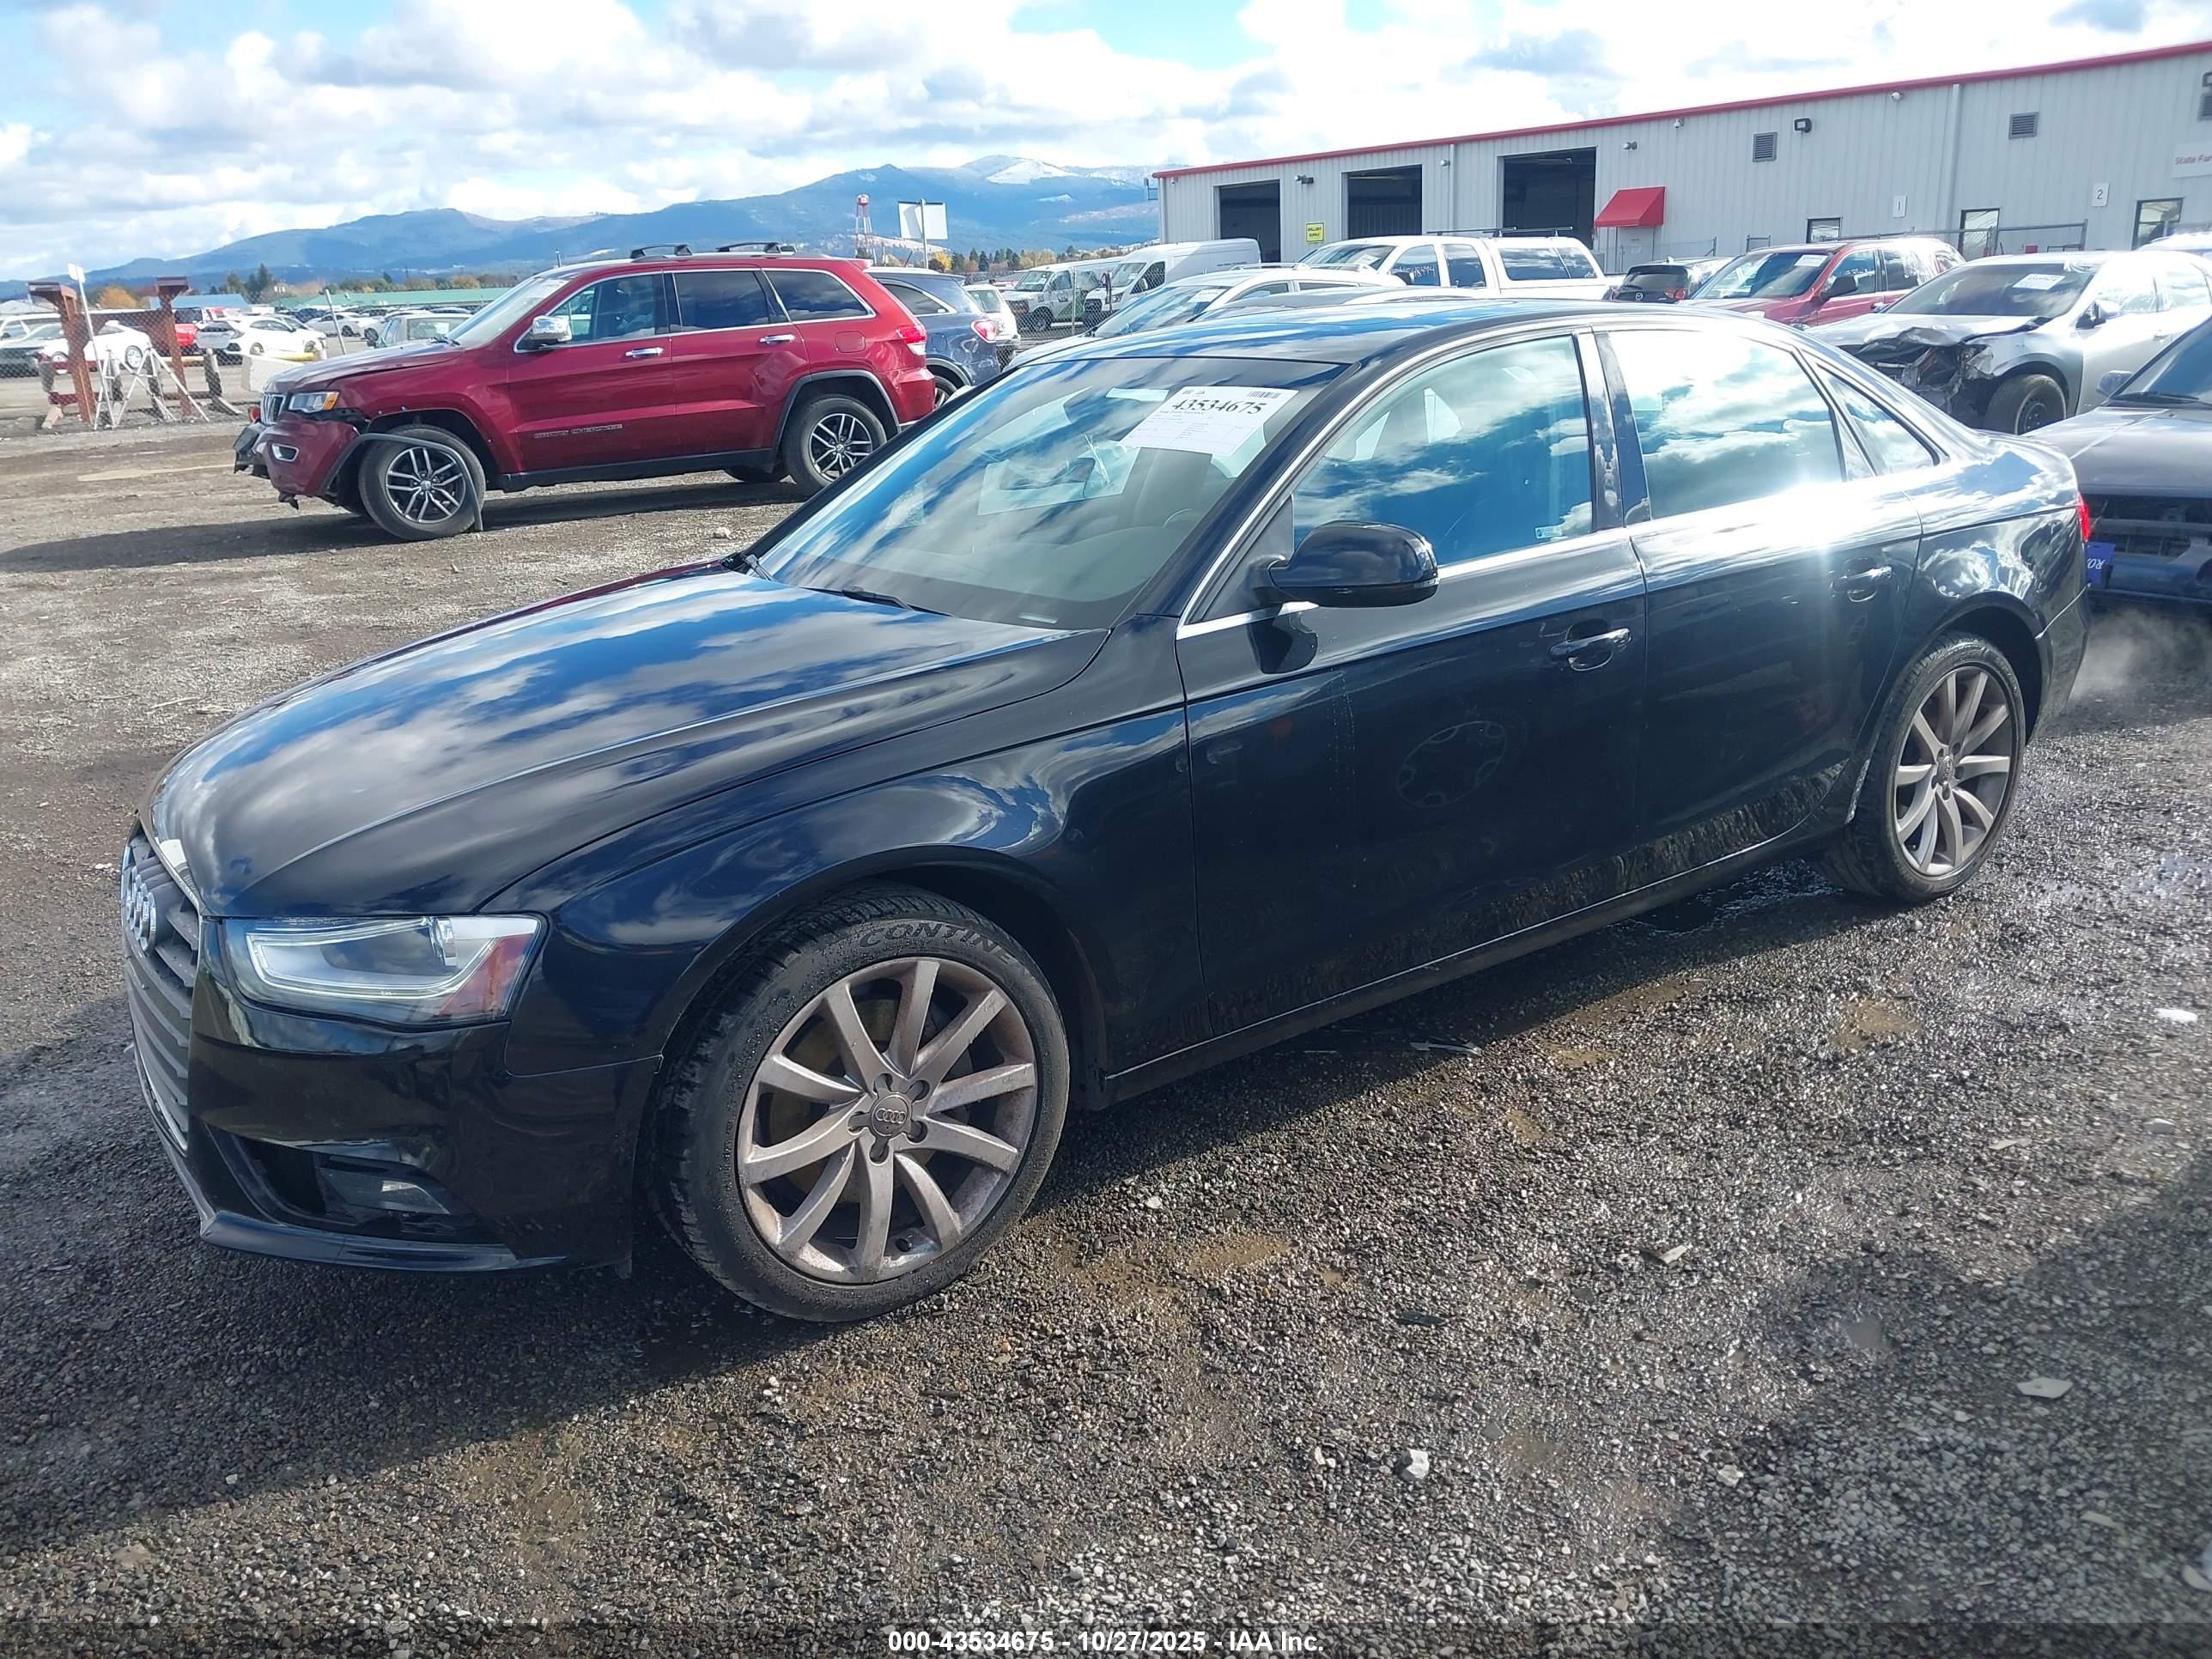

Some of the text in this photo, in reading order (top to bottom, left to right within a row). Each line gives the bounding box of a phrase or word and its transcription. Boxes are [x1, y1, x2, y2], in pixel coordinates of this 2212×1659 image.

[2198, 154, 2212, 163] Far
[2096, 189, 2103, 200] 2
[1171, 399, 1267, 415] 43534675
